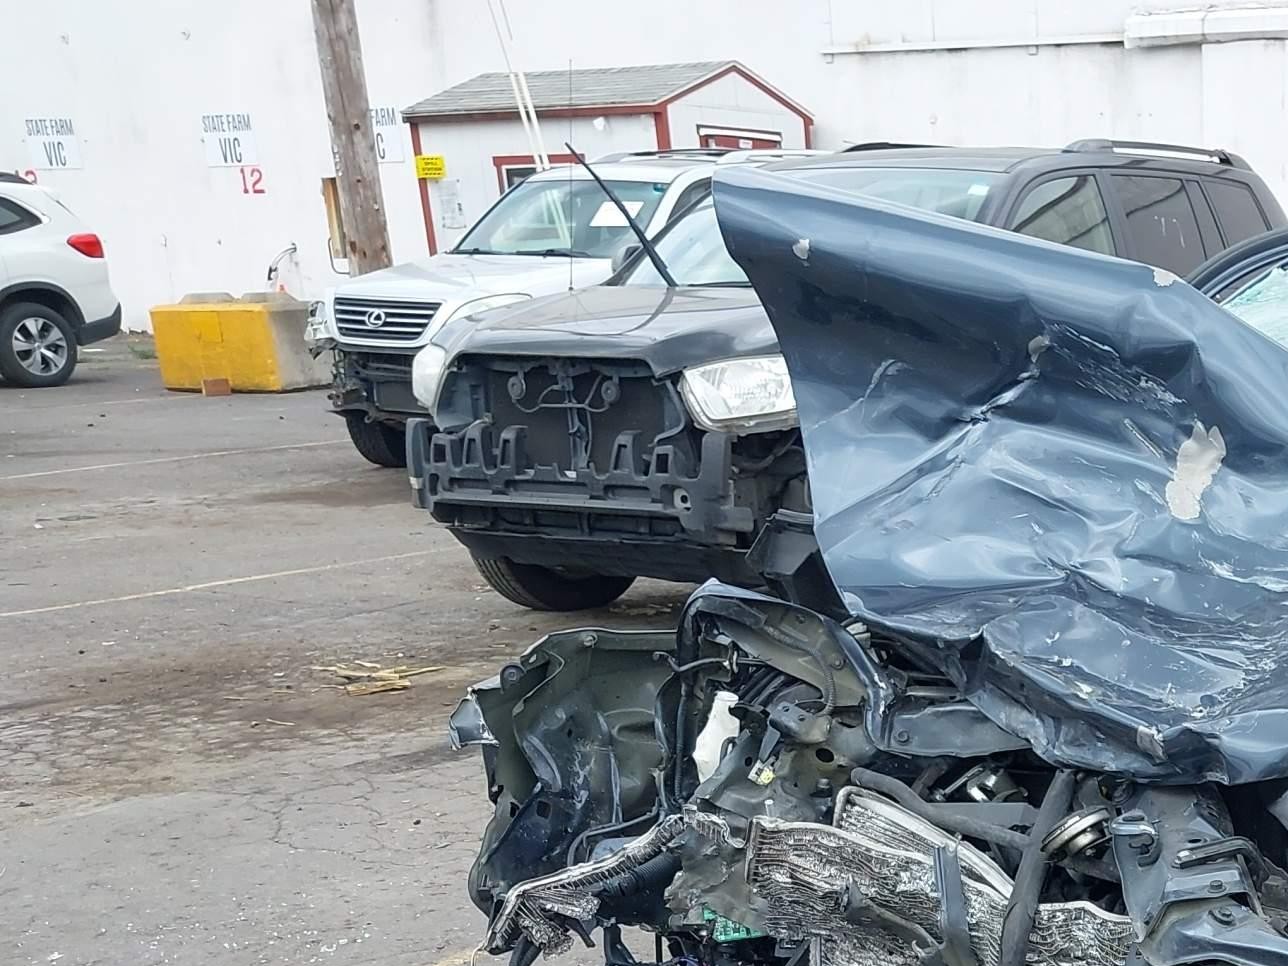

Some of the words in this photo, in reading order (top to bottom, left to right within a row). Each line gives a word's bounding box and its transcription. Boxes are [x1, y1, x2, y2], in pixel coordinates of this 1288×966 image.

[25, 118, 50, 136] STATE
[50, 118, 75, 136] FARM
[202, 114, 226, 133] STATE
[226, 113, 252, 132] FARM
[42, 141, 67, 167] VIC
[218, 137, 243, 163] VIC
[240, 167, 266, 194] 12
